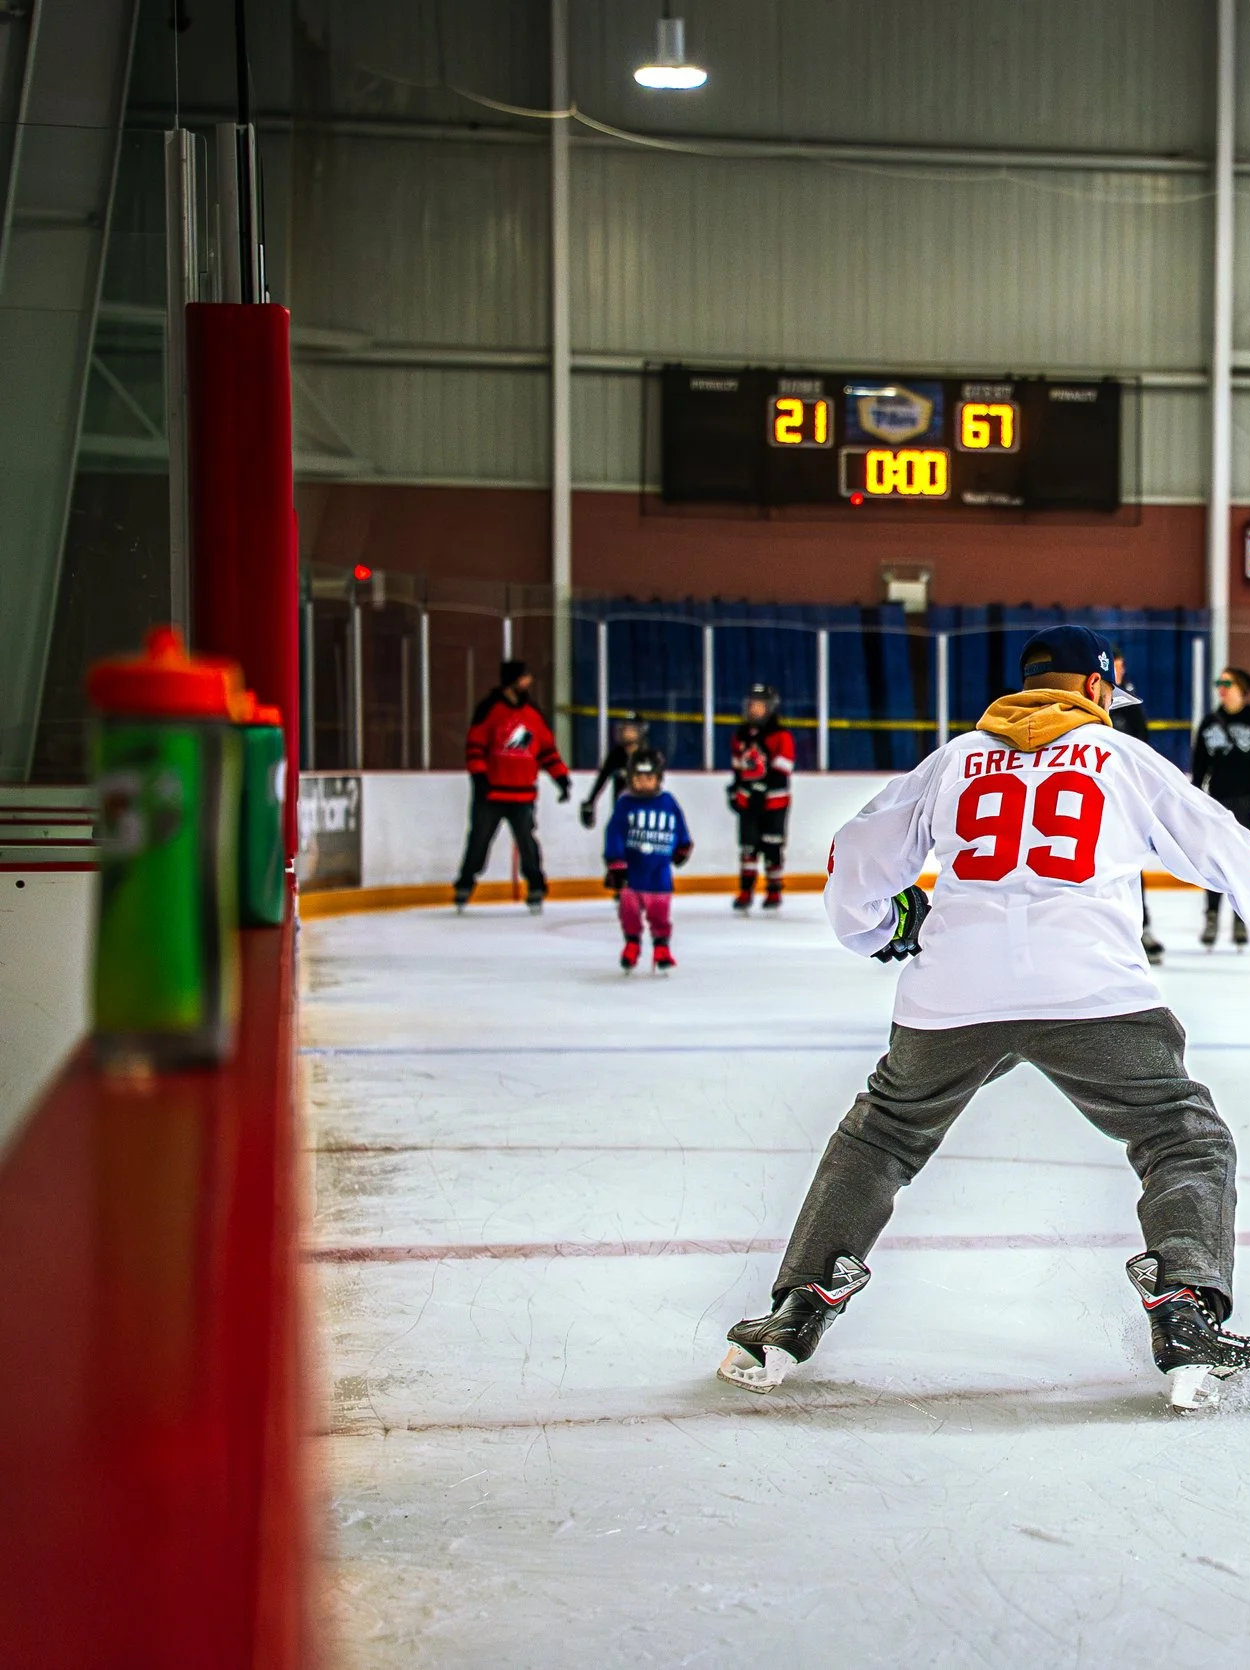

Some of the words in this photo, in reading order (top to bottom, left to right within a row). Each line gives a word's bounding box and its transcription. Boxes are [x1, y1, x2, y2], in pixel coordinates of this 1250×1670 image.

[775, 397, 827, 444] 21
[961, 403, 1014, 449] 67
[866, 449, 948, 495] 0:00
[964, 744, 1112, 779] GRETZKY
[951, 770, 1106, 884] 99
